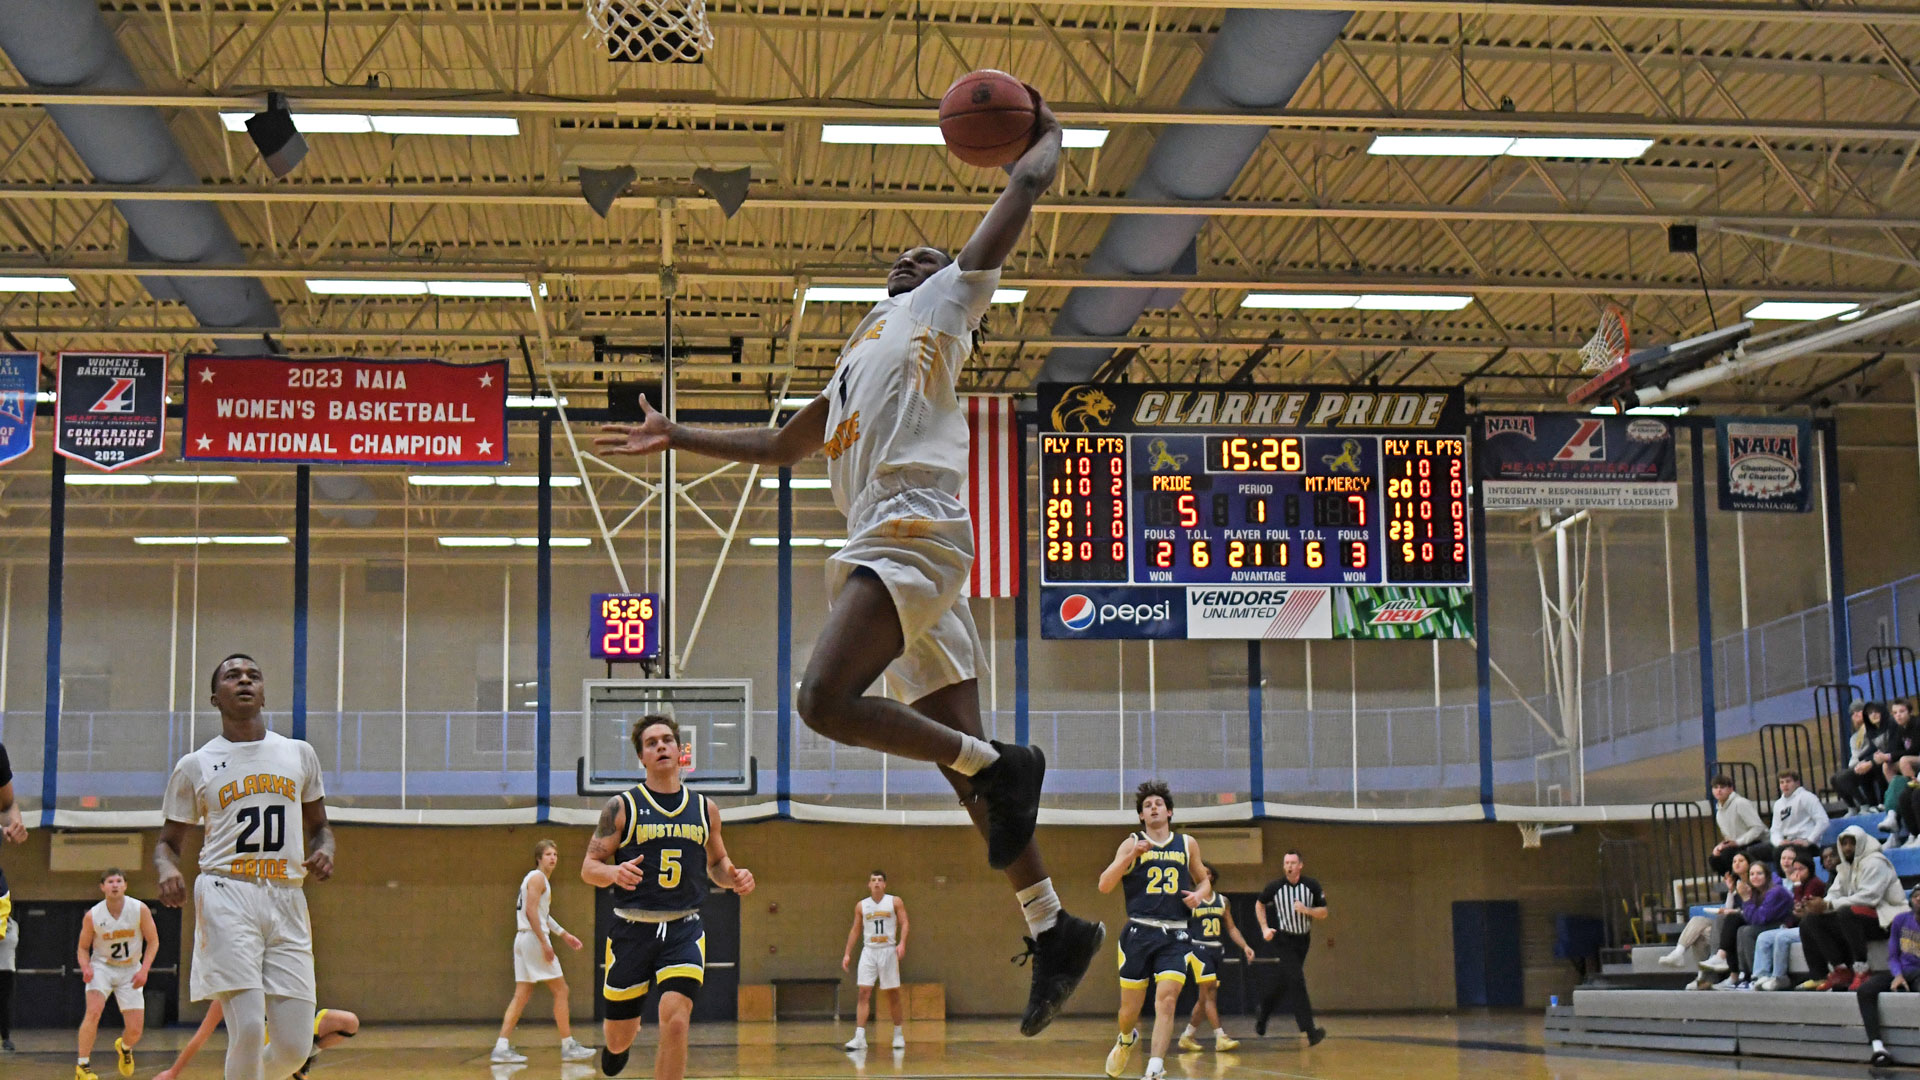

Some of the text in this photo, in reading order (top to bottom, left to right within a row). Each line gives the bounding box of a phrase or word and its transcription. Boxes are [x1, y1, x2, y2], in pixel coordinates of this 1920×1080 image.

[77, 367, 146, 376] BASKETBALL
[89, 358, 139, 367] WOMEN'S
[288, 368, 407, 389] 2023 NAIA
[217, 398, 475, 422] WOMEN'S BASKETBALL
[1133, 391, 1448, 428] CLARKE PRIDE
[67, 428, 154, 438] CONFERENCE
[1488, 418, 1533, 435] NAIA
[75, 437, 146, 446] CHAMPION
[228, 432, 462, 455] NATIONAL CHAMPION
[1044, 438, 1123, 453] PLY FL PTS
[1385, 440, 1462, 455] PLY FL PTS
[1733, 437, 1794, 460] NAIA
[95, 450, 124, 461] 2022
[1222, 438, 1300, 471] 15:26
[1065, 457, 1122, 475] 1 0 0
[1406, 459, 1461, 477] 1 0 2
[1501, 463, 1556, 472] HEART
[1580, 462, 1657, 473] AMERICA
[1741, 464, 1785, 473] Champions
[1053, 478, 1123, 495] 11 0 2
[1152, 475, 1192, 491] PRIDE
[1239, 484, 1273, 494] PERIOD
[1305, 477, 1370, 492] MT.MERCY
[1388, 478, 1462, 498] 20 0 0
[1488, 487, 1671, 496] INTEGRITY RESPONSIBILITY RESPECT
[1047, 498, 1123, 518] 20 1 3
[1395, 501, 1463, 519] 11 0 0
[1487, 497, 1674, 506] SPORTSMANSHIP SERVANT LEADERSHIP
[1178, 495, 1198, 527] 5
[1258, 500, 1265, 523] 1
[1348, 496, 1365, 526] 7
[1048, 519, 1123, 539] 21 1 0
[1144, 530, 1175, 539] FOULS
[1186, 530, 1212, 539] T.O.L.
[1224, 530, 1290, 540] PLAYER FOUL
[1300, 530, 1326, 540] T.O.L.
[1338, 531, 1369, 540] FOULS
[1389, 520, 1463, 540] 23 1 3
[1048, 541, 1124, 561] 23 0 0
[1157, 541, 1172, 567] 2
[1192, 541, 1209, 568] 6
[1306, 541, 1323, 568] 6
[1352, 542, 1366, 568] 3
[1402, 542, 1464, 562] 5 0 2
[1150, 572, 1172, 581] WON
[1231, 571, 1286, 581] ADVANTAGE
[1344, 572, 1366, 582] WON
[1191, 590, 1288, 605] VENDORS
[602, 599, 653, 620] 15:26
[1100, 600, 1170, 624] pepsi
[1202, 607, 1276, 618] UNLIMITED
[603, 619, 644, 654] 28
[219, 774, 295, 809] CLARKE
[236, 805, 285, 853] 20
[637, 823, 704, 845] MUSTANGS
[658, 849, 682, 888] 5
[1146, 866, 1179, 894] 23
[874, 920, 884, 934] 11
[1202, 918, 1220, 936] 20
[110, 942, 129, 959] 21
